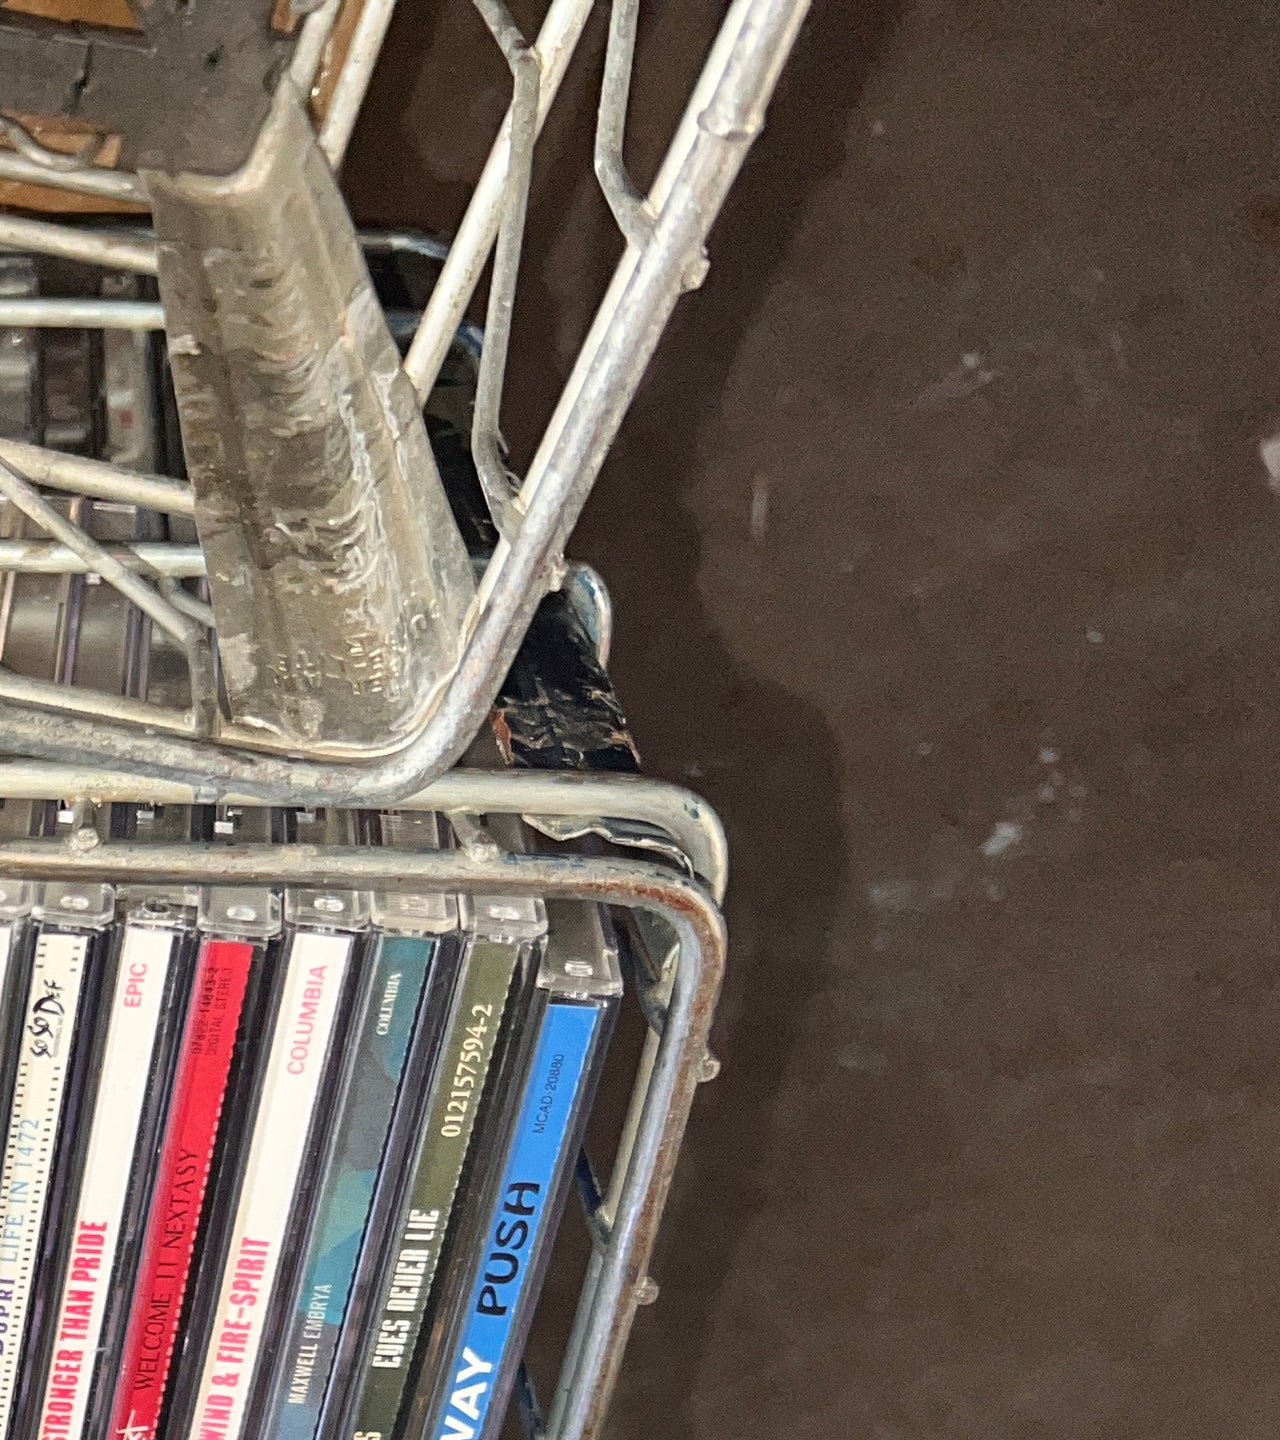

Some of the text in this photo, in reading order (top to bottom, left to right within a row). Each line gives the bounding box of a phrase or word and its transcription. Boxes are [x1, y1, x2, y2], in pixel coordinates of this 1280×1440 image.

[122, 962, 149, 1008] EPIC
[286, 964, 329, 1074] COLUMBIA
[374, 974, 402, 1038] COLUMBIA
[438, 1003, 494, 1139] 012157594-2
[70, 1219, 108, 1283] PRIDE
[132, 1146, 202, 1391] WELCOME IT NEXTASY
[213, 1235, 272, 1363] FIRE-SPIRIT
[473, 1179, 542, 1317] PUSH
[59, 1288, 95, 1340] THAN
[288, 1284, 332, 1404] MAXWELL EMBRYA
[209, 1372, 239, 1386] &
